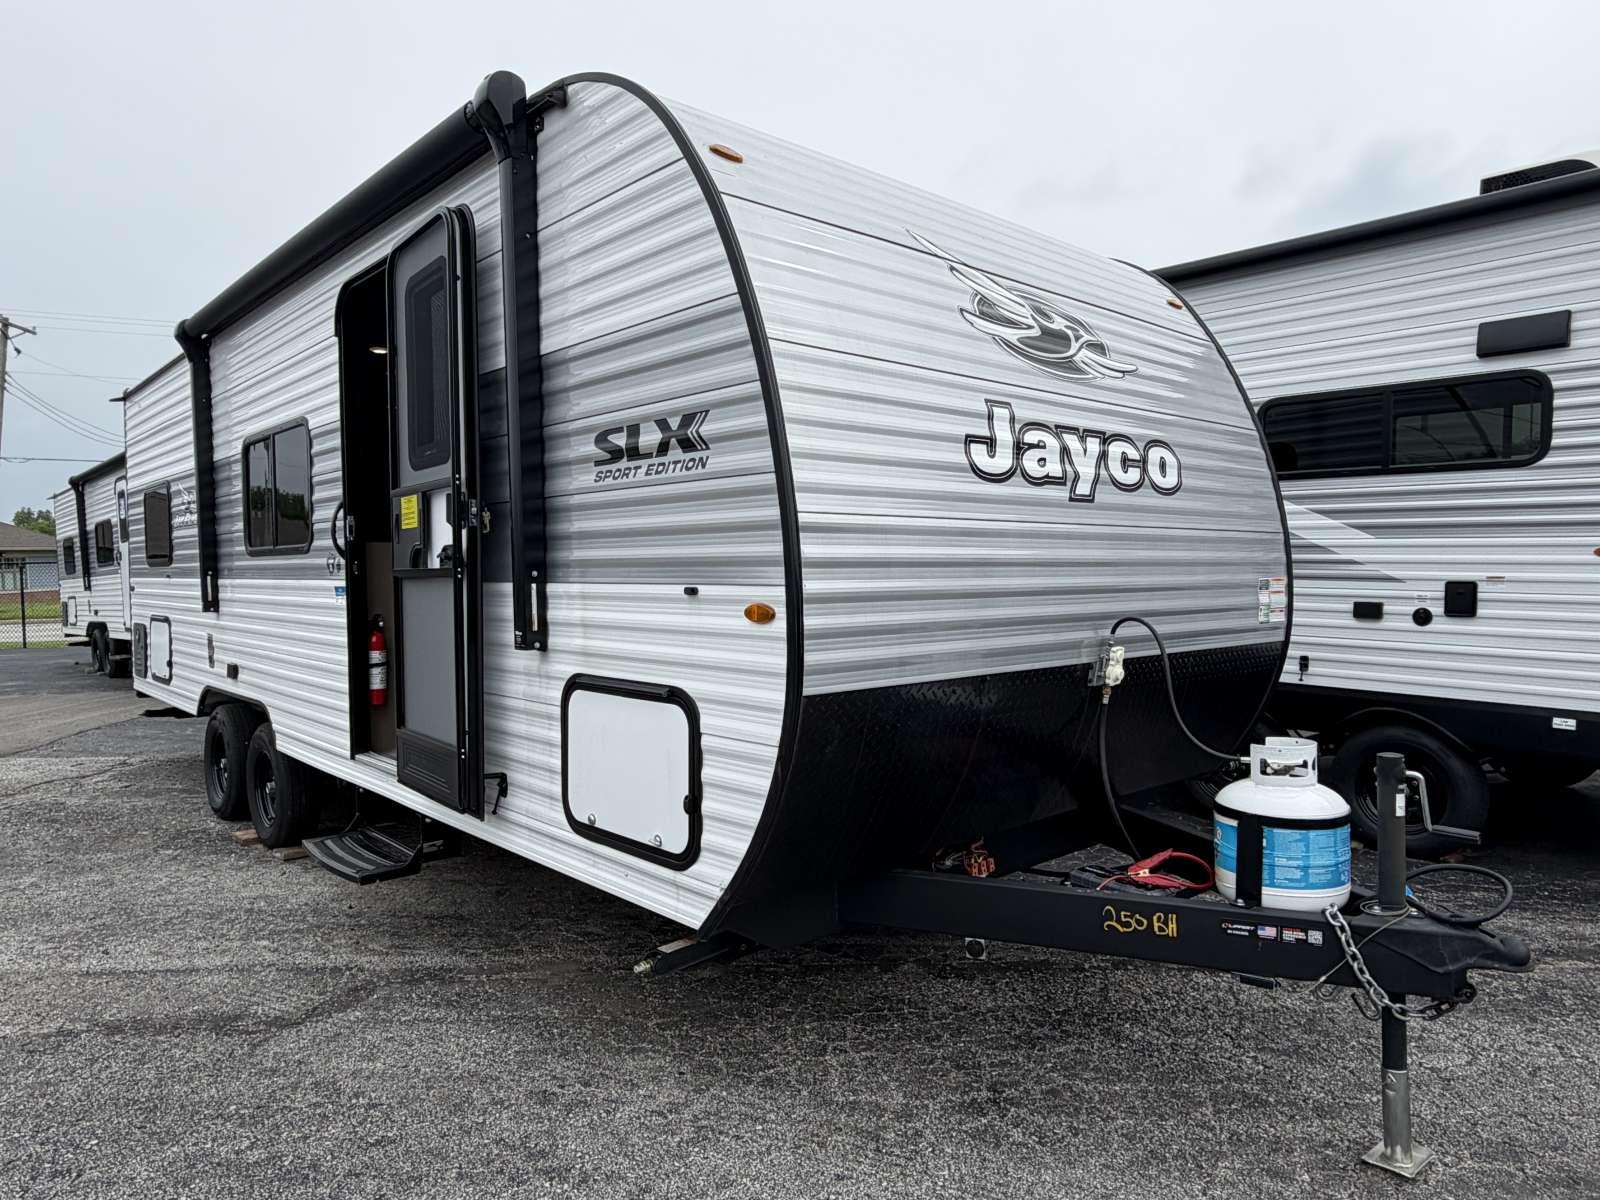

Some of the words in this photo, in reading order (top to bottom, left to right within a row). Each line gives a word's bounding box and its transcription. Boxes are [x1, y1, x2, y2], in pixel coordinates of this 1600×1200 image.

[593, 409, 711, 467] SLX
[964, 398, 1182, 503] Jayco
[594, 465, 642, 483] SPORT
[644, 455, 710, 477] EDITION
[1102, 905, 1148, 933] 250
[1152, 912, 1178, 938] BH
